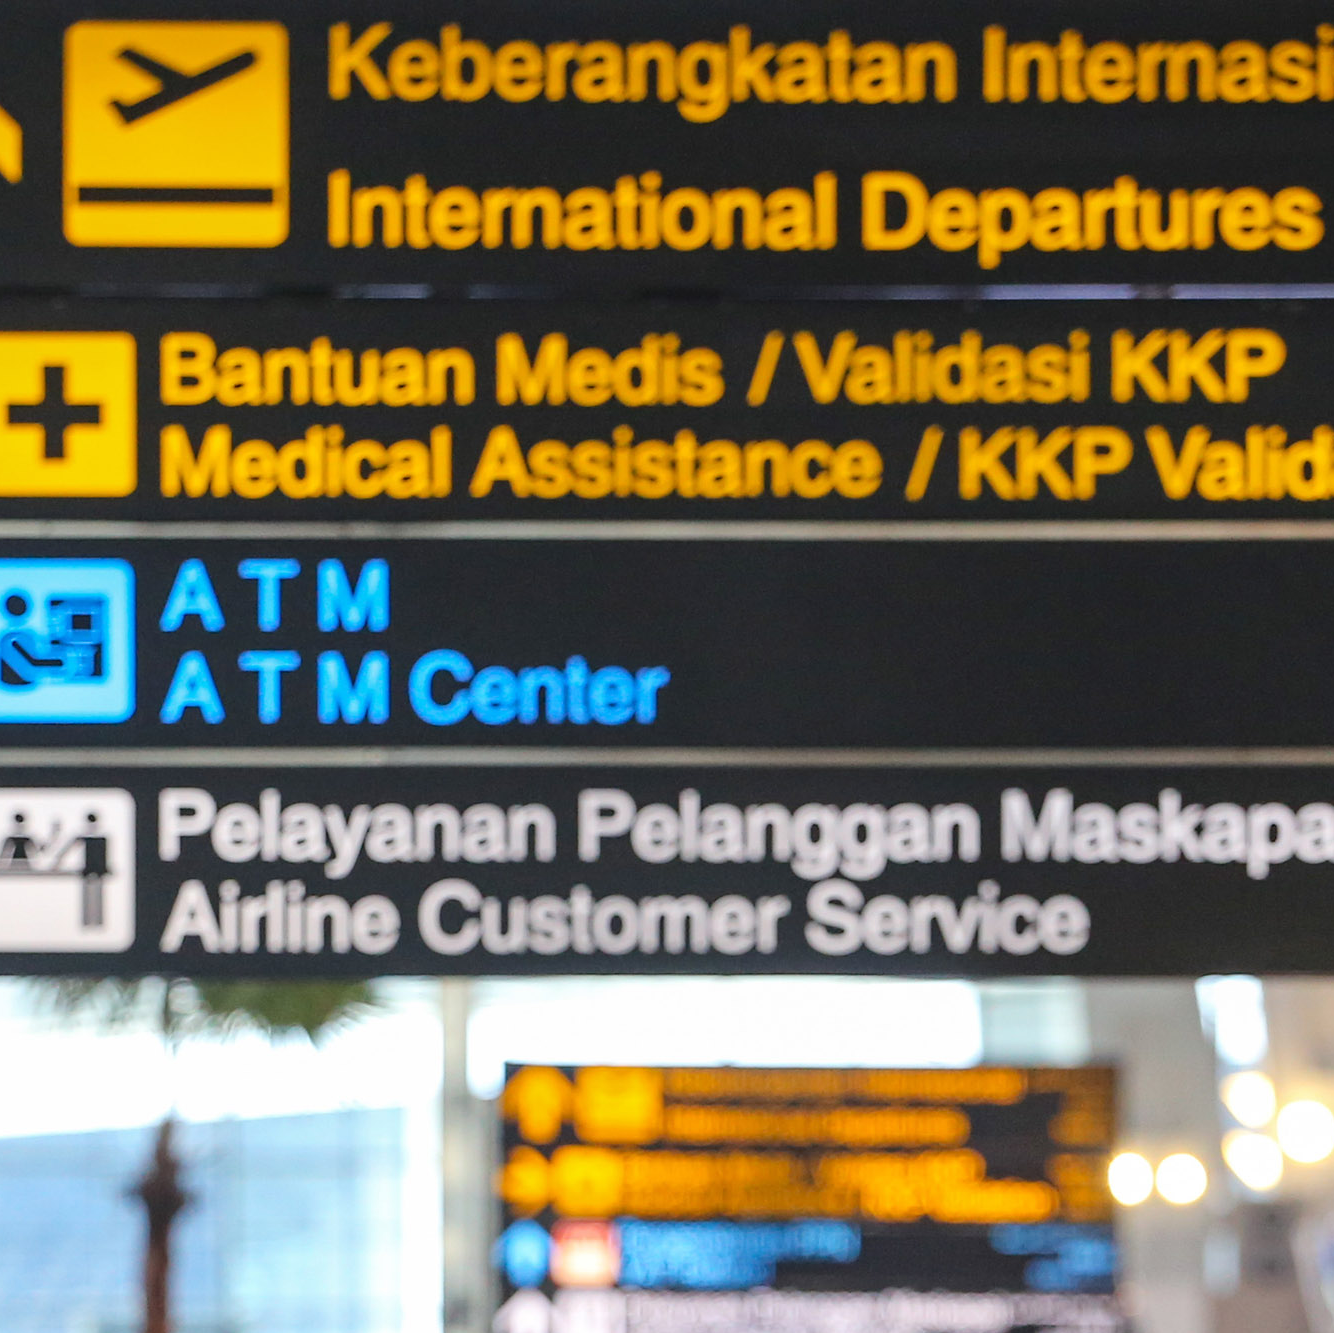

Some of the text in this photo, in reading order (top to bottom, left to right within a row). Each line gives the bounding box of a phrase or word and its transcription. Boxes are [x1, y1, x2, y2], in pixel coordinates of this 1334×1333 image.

[327, 22, 958, 123] Keberangkatan
[327, 168, 1325, 270] International Departures
[159, 332, 476, 407] Bantuan
[495, 332, 726, 407] Medis
[1110, 328, 1287, 404] KKP
[159, 424, 453, 500] Medical
[468, 424, 884, 500] Assistance
[958, 425, 1134, 501] KKP
[407, 648, 672, 727] Center
[157, 787, 557, 880] Pelayanan
[577, 787, 981, 881] Pelanggan
[159, 877, 1091, 956] Airline Customer Service
